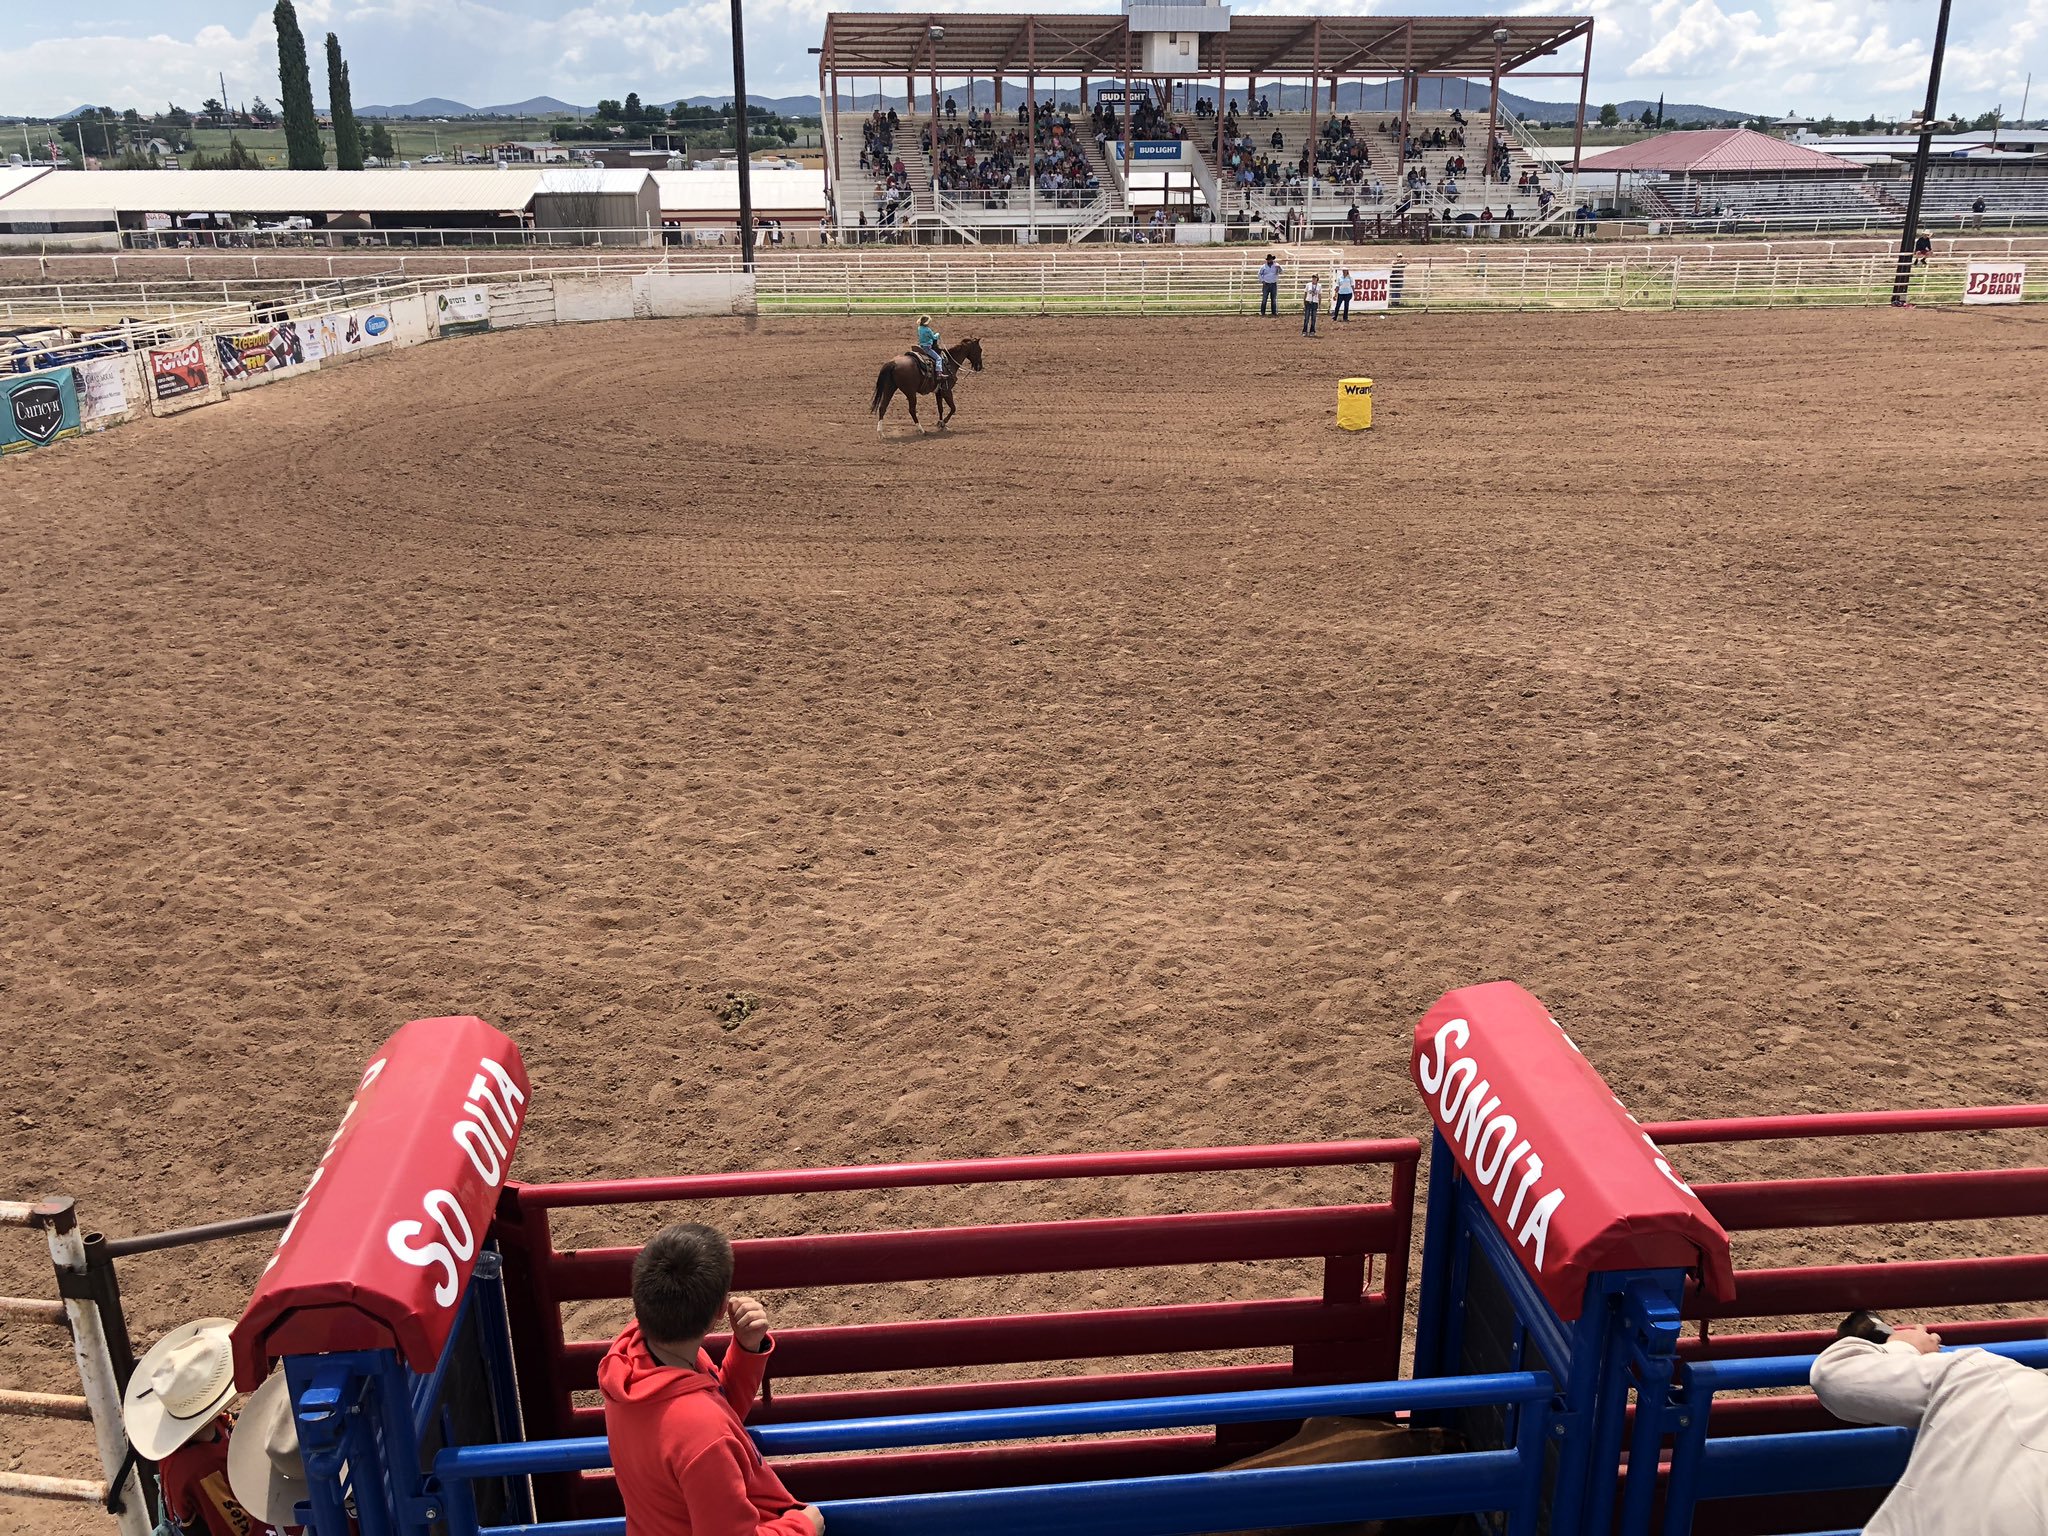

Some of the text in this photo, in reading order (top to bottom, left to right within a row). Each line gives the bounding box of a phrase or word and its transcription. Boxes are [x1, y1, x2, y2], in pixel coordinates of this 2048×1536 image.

[1101, 92, 1146, 101] BUD LGHT
[1139, 146, 1177, 154] BUD LIGHT
[1990, 272, 2022, 284] BOOT
[1354, 279, 1388, 290] BOOT
[1987, 284, 2021, 295] BARN
[1353, 290, 1387, 302] BARN
[153, 345, 200, 373] FORCO
[245, 353, 266, 370] RV
[15, 398, 60, 421] Curicyn
[1419, 1018, 1566, 1273] SONOITA
